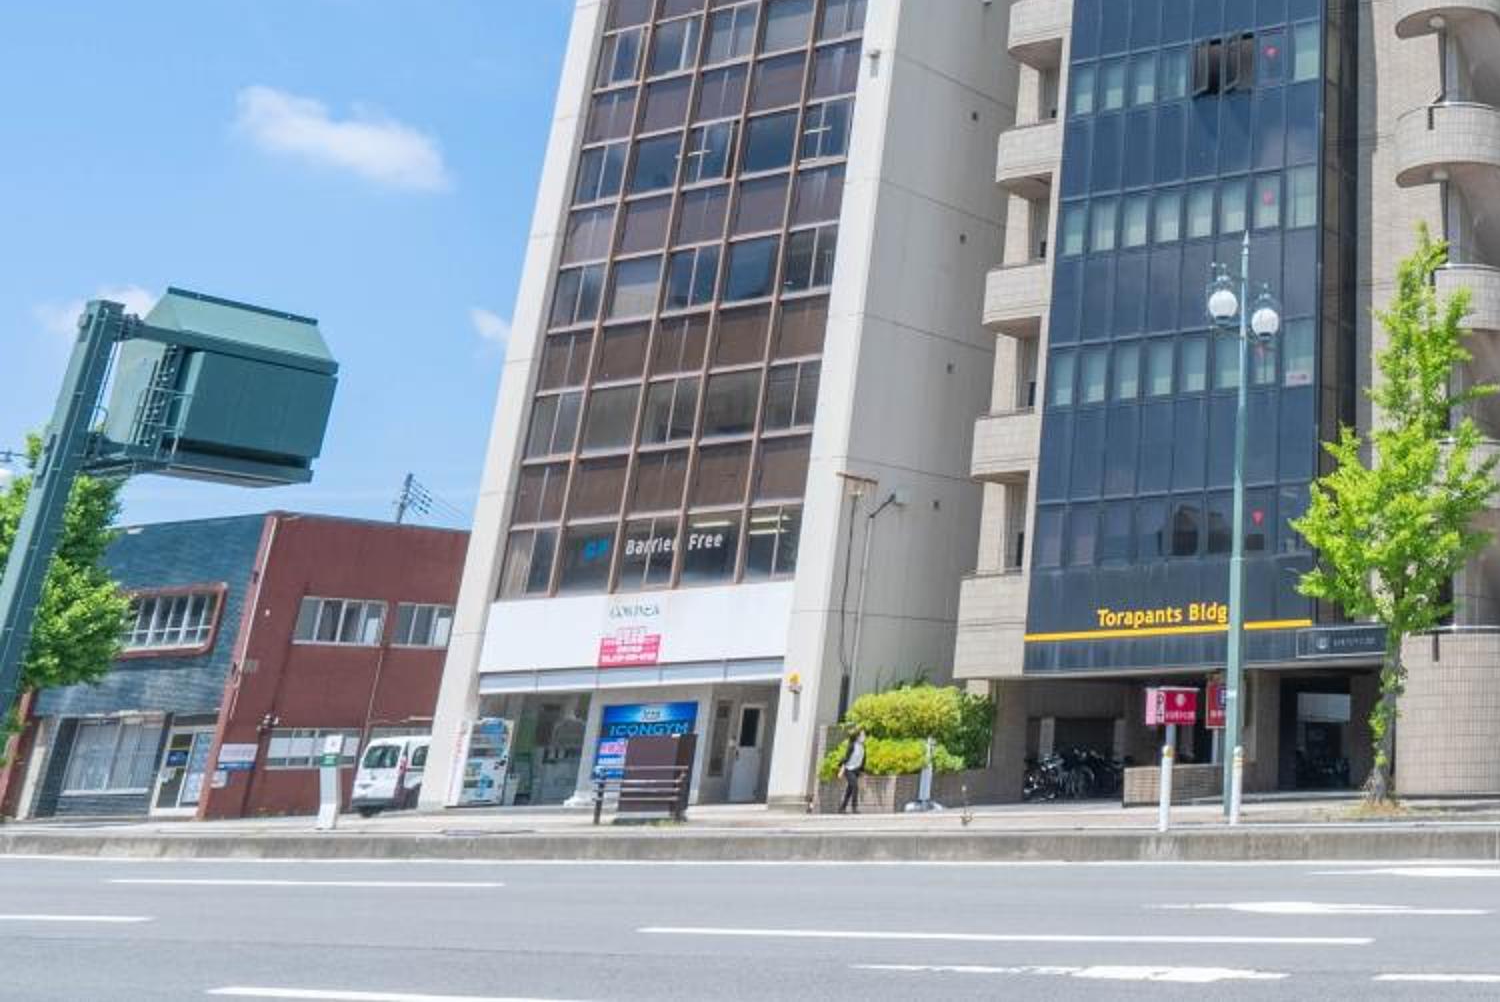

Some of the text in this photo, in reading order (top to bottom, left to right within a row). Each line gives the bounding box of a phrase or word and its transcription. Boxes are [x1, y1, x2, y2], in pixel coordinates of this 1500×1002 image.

[625, 536, 678, 555] Barrie
[688, 534, 723, 550] Free
[1097, 606, 1183, 629] Torapants
